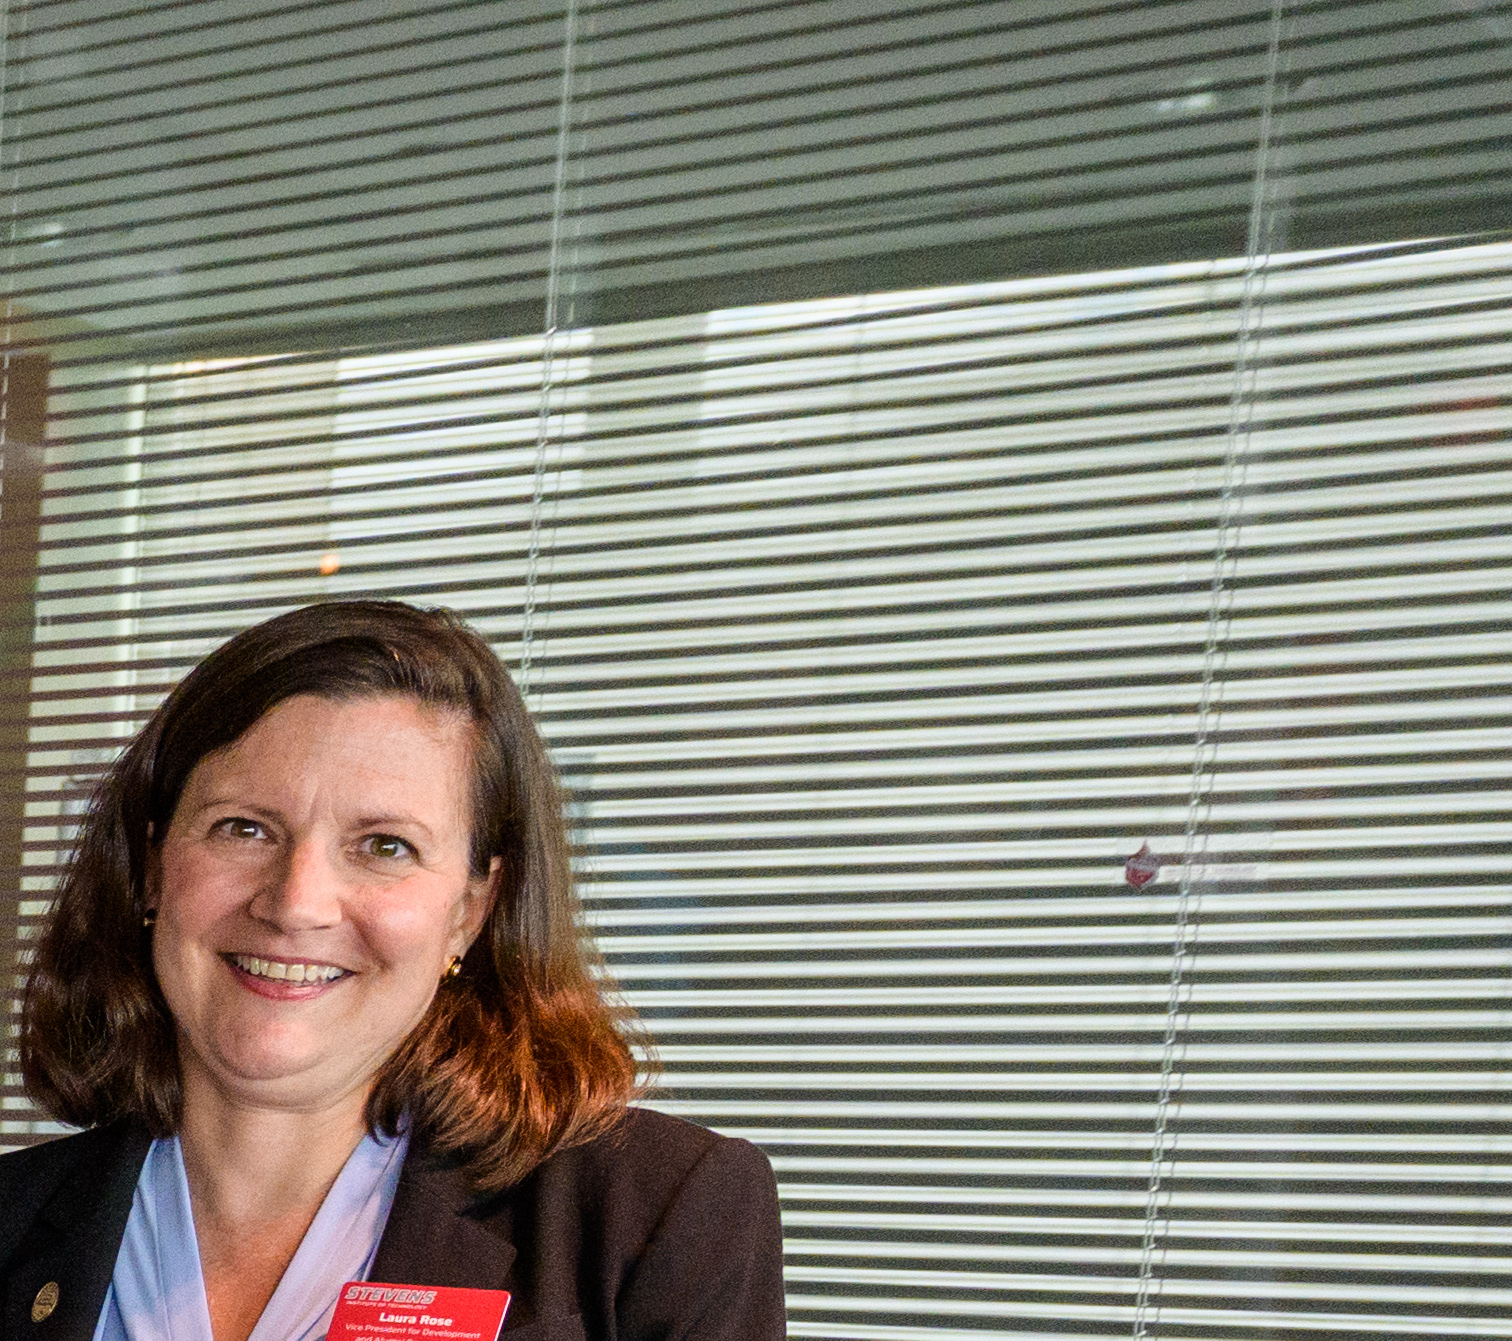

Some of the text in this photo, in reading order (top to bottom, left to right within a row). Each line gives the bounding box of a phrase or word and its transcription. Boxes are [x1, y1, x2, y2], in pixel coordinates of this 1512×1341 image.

[345, 1286, 437, 1304] STEVENS
[379, 1312, 453, 1327] Laura Rose
[345, 1324, 481, 1339] Vice President for Development
